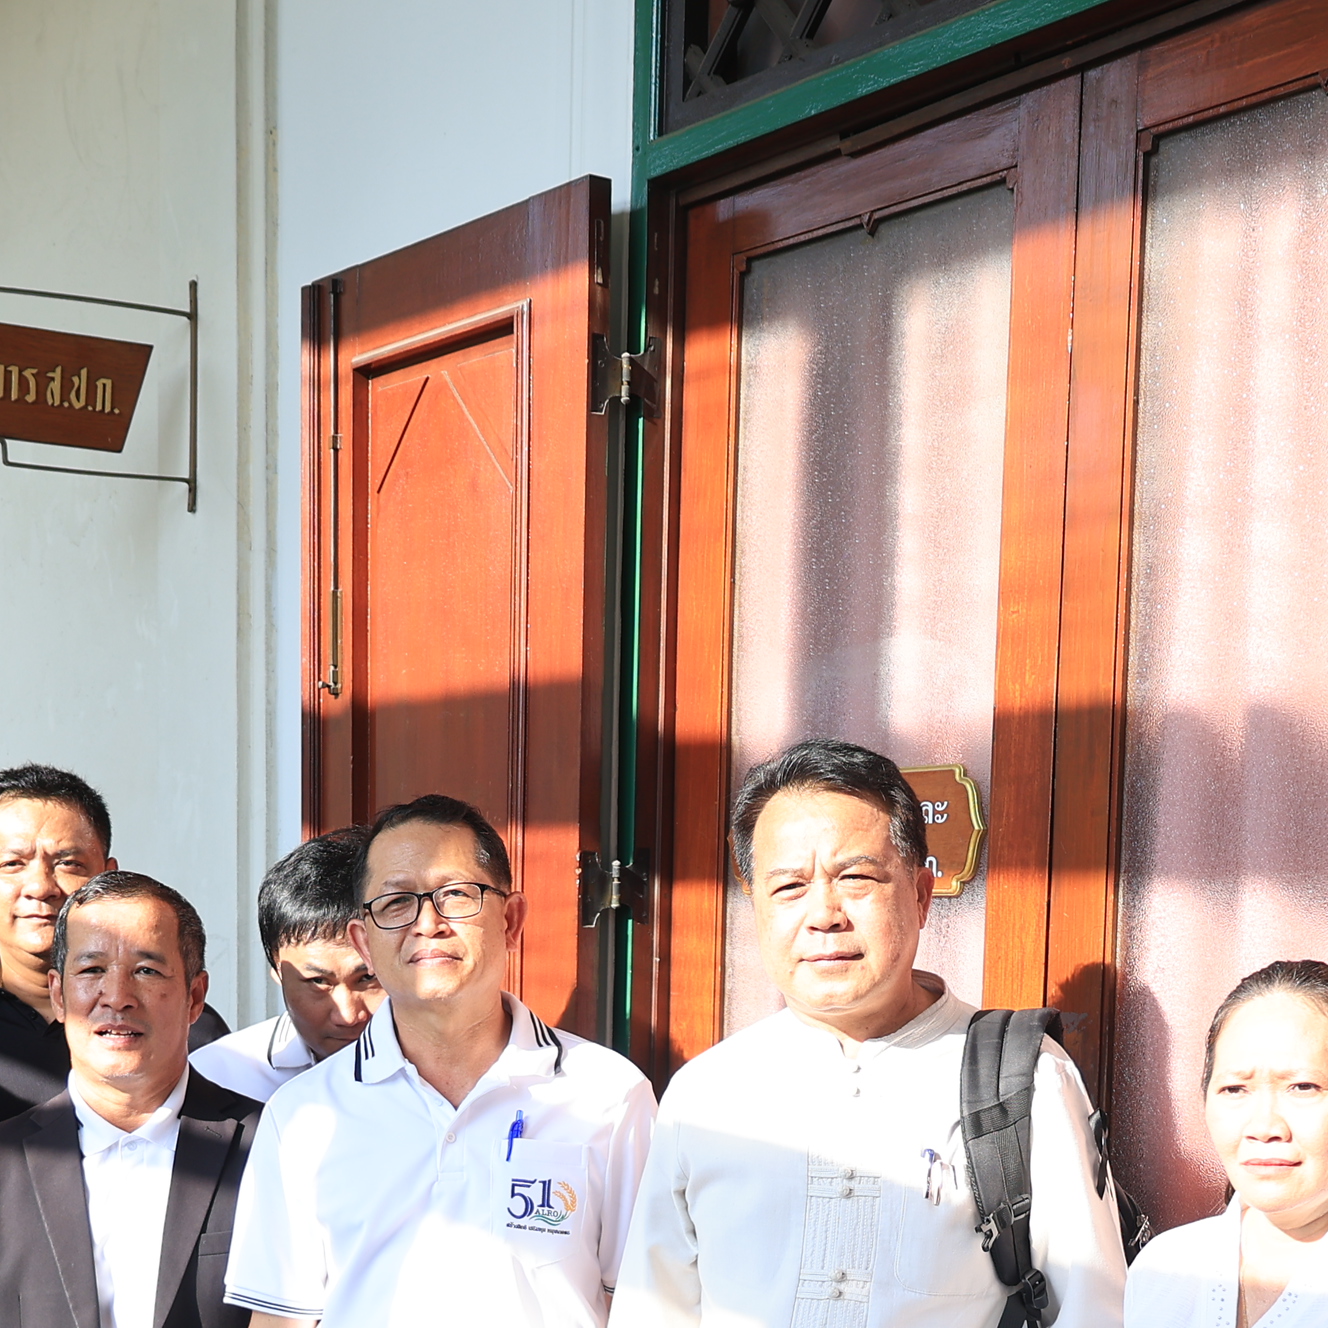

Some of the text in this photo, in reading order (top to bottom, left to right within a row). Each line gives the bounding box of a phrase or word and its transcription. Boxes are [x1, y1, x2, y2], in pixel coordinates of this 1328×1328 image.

[46, 365, 120, 414] ส.ป.ก.
[507, 1178, 554, 1219] 51
[534, 1208, 559, 1218] ALRO
